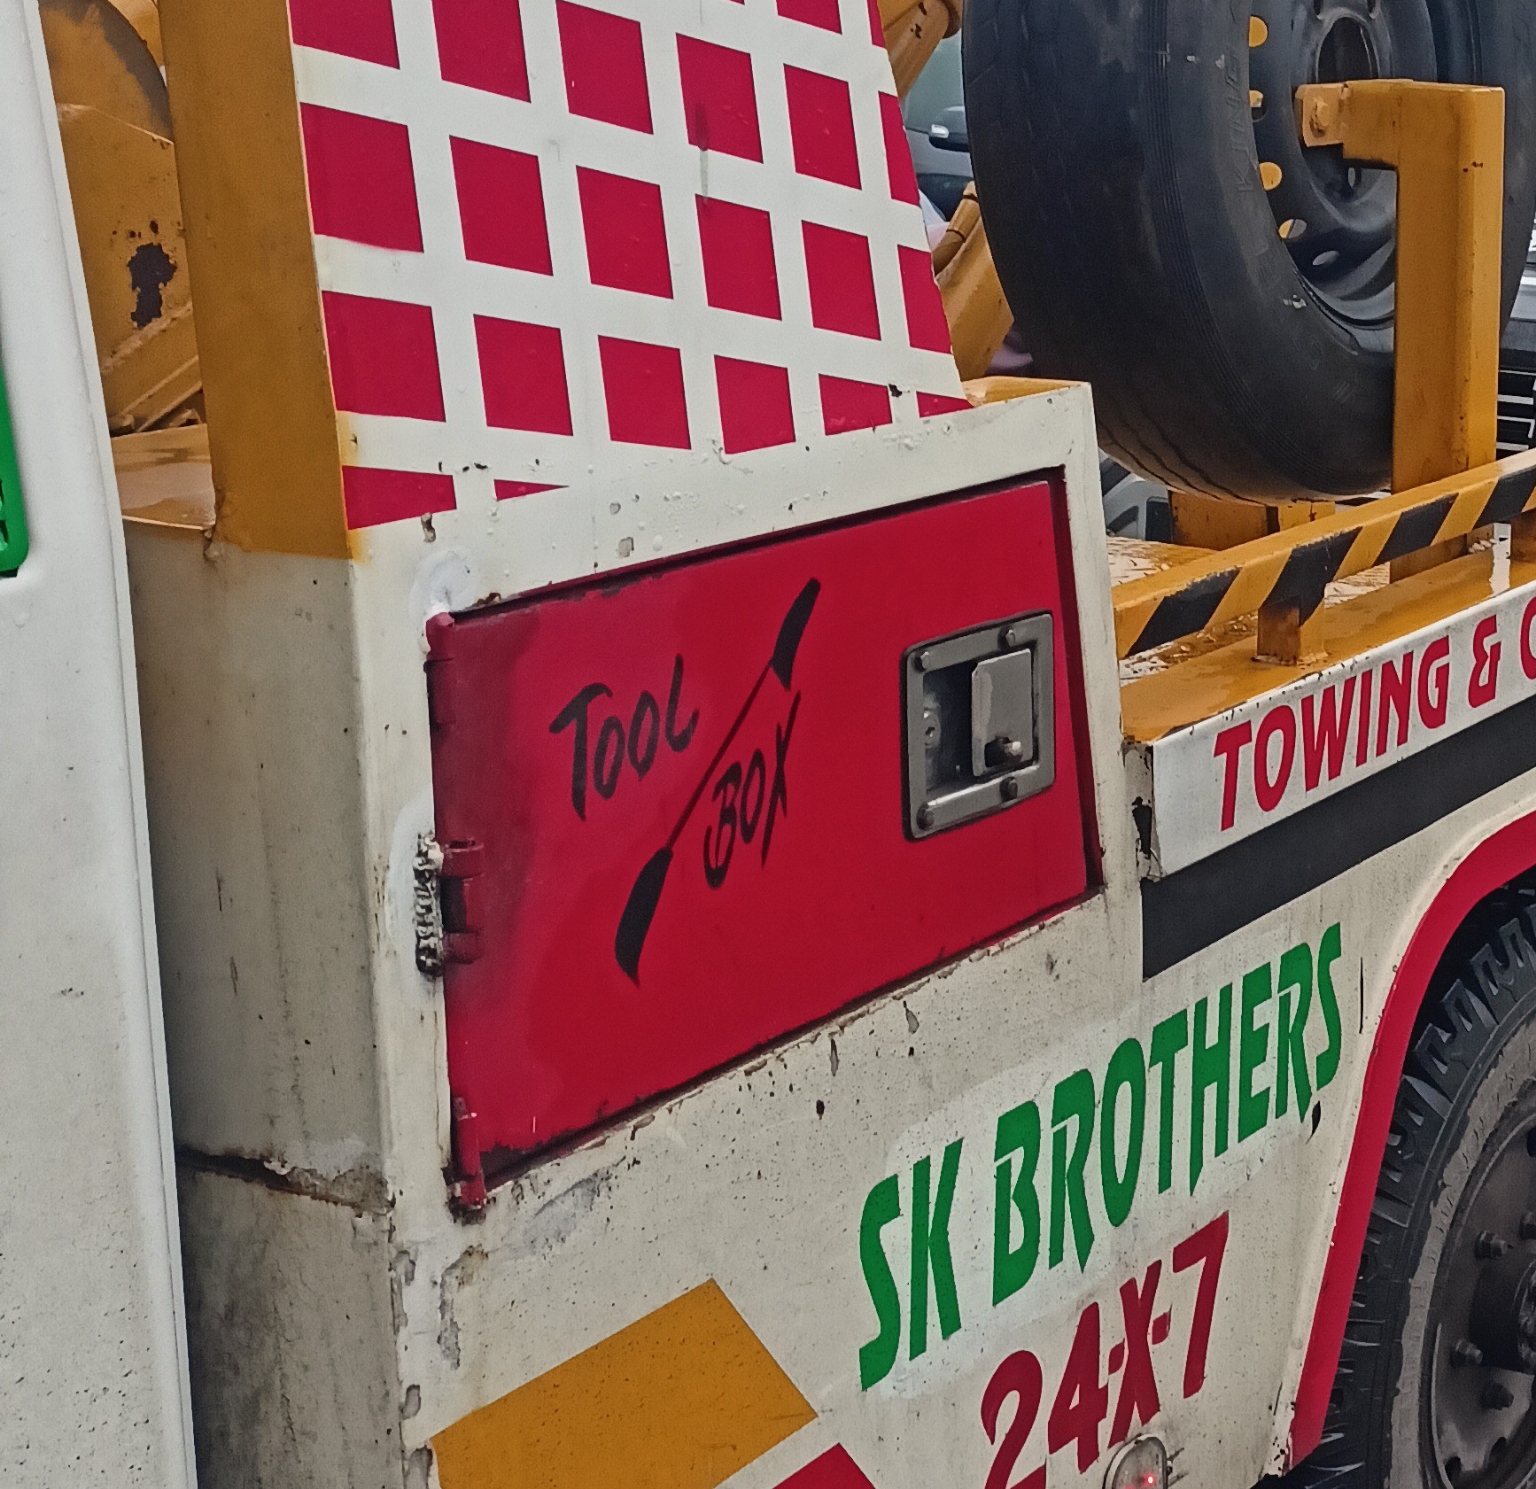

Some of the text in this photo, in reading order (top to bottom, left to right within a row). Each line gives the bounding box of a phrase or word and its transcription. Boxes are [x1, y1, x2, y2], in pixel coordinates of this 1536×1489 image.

[549, 652, 700, 822] TOOL
[703, 689, 802, 890] BOX
[1213, 634, 1450, 833] TOWING
[1468, 614, 1502, 709] &
[858, 921, 1342, 1392] SK BROTHERS
